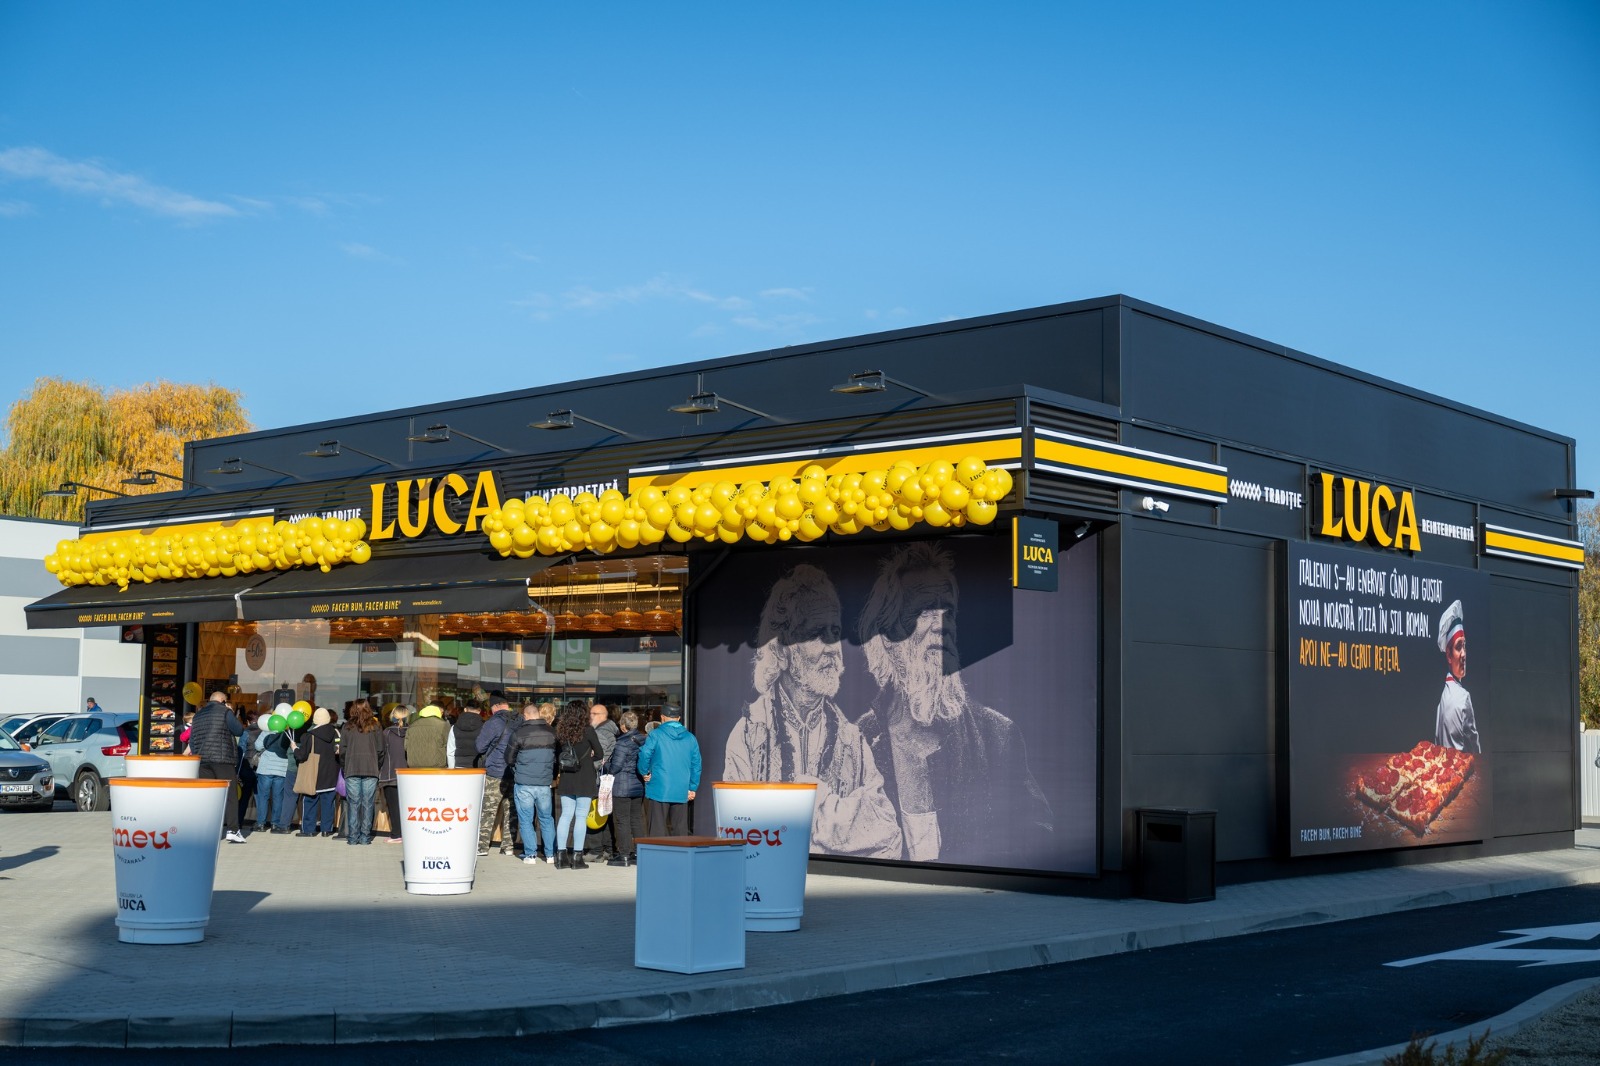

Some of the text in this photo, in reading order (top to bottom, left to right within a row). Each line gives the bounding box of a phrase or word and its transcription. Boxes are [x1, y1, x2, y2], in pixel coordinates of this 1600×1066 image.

[369, 470, 502, 540] LUCA
[1321, 472, 1421, 552] LUCA
[1421, 518, 1475, 542] REINTERPRETATĂ
[1023, 545, 1054, 564] LUCA
[1299, 558, 1332, 590] ITALIENII
[1357, 568, 1387, 597] ENERVAT
[1389, 567, 1409, 600] CÂND
[1411, 575, 1419, 600] AU
[1421, 578, 1443, 604] GUSTAT
[331, 602, 349, 612] FACEM
[365, 601, 384, 611] FACEM
[1299, 598, 1431, 639] NOUA NOASTRĂ PIZZA ÎN STIL ROMAN.
[1299, 637, 1318, 667] APOI
[1350, 643, 1372, 670] CERUT
[1300, 828, 1318, 842] FACEM
[1332, 826, 1349, 840] FACEM
[422, 861, 451, 870] LUCA
[745, 891, 761, 902] CA
